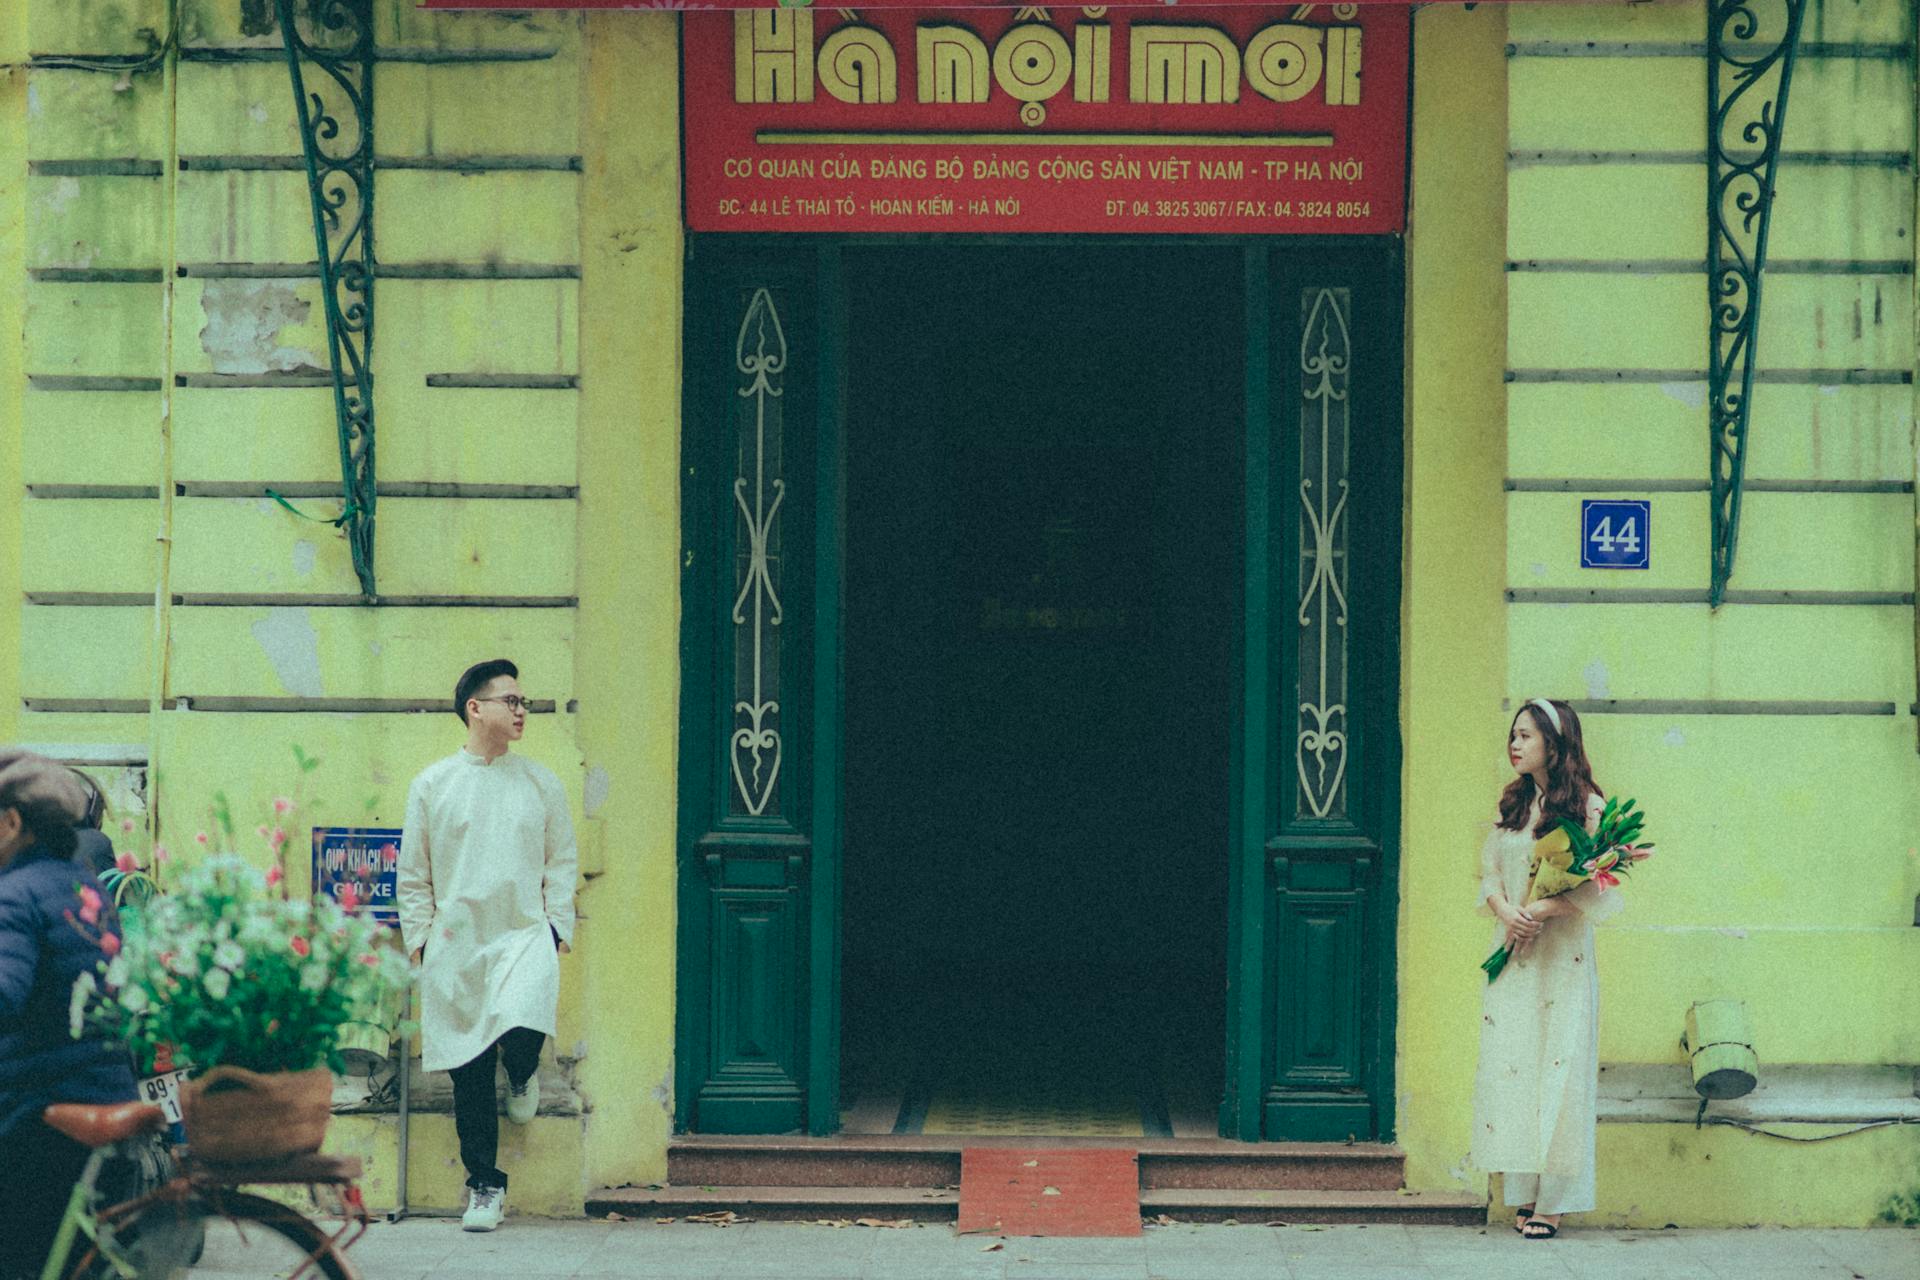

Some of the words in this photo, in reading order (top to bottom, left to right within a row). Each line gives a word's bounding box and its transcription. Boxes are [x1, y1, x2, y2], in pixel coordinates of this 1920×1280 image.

[724, 157, 753, 179] CƠ
[758, 159, 814, 180] QUAN
[821, 152, 862, 180] CỦA
[870, 152, 928, 180] ĐẢNG
[935, 155, 965, 184] BỘ
[973, 152, 1030, 180] ĐẢNG
[1038, 155, 1094, 184] CỘNG
[1100, 153, 1142, 180] SẢN
[1148, 155, 1192, 184] VIỆT
[1199, 160, 1244, 181] NAM
[1264, 160, 1289, 181] TP
[1329, 157, 1363, 186] NỘI
[749, 199, 768, 216] 44
[772, 195, 792, 216] LÊ
[917, 193, 954, 216] KIẾM
[1155, 201, 1190, 217] 3825
[1298, 201, 1332, 218] 3824
[1336, 201, 1371, 219] 8054
[1590, 516, 1641, 553] 44
[369, 882, 392, 897] XE
